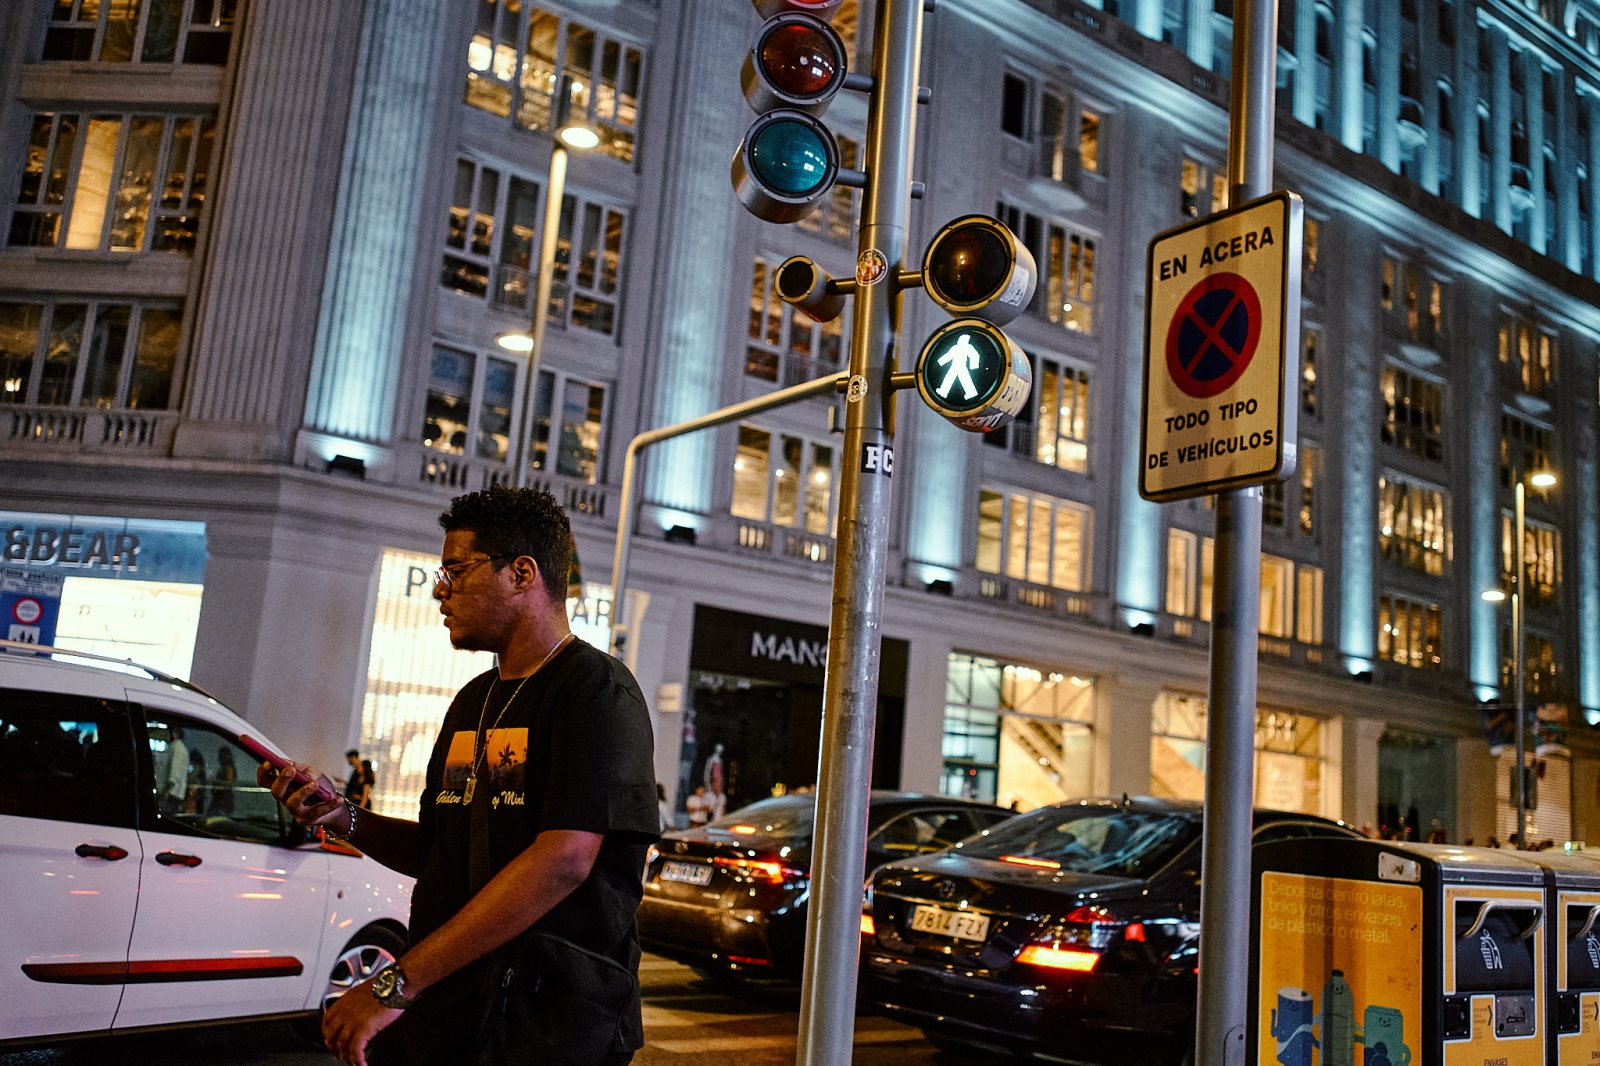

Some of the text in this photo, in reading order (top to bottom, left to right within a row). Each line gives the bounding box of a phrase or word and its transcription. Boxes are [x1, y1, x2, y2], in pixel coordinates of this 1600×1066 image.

[1160, 226, 1274, 281] EN ACERA
[1165, 398, 1258, 433] TODO TIPO
[1148, 429, 1274, 474] DE VEHÍCULOS
